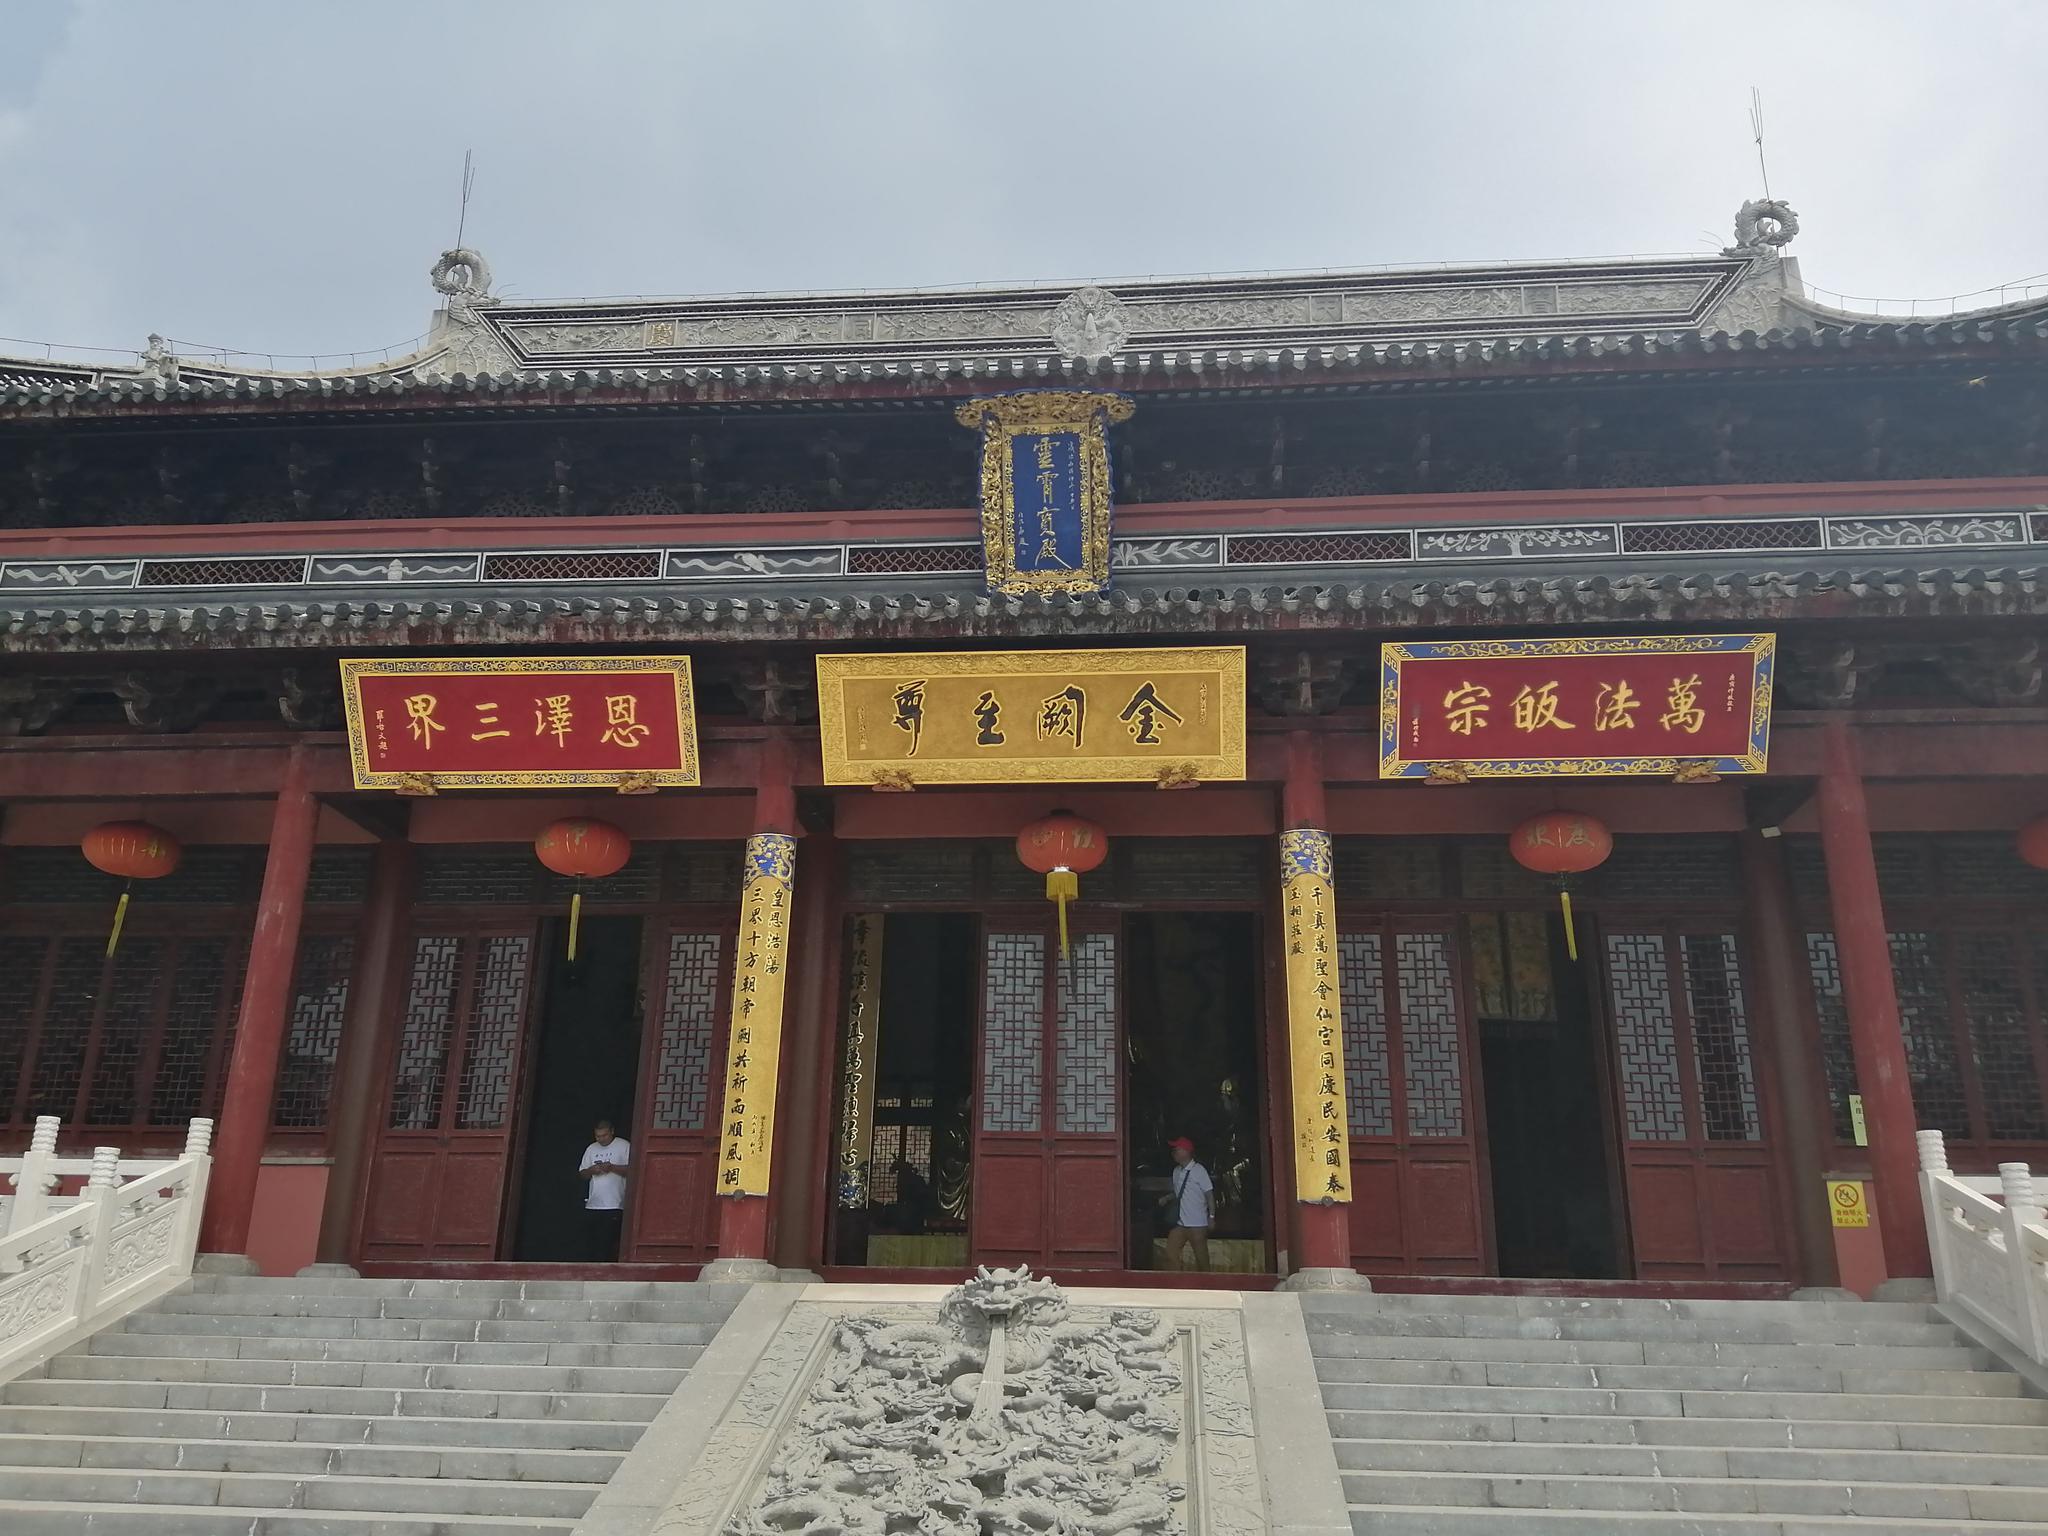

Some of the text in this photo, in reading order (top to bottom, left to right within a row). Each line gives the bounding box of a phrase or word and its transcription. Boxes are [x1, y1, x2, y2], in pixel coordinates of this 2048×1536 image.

[404, 693, 650, 750] 恩澤三界
[890, 678, 1183, 757] 金闕至尊
[1442, 673, 1706, 736] 萬法皈宗
[765, 888, 784, 975] 皇恩浩蕩
